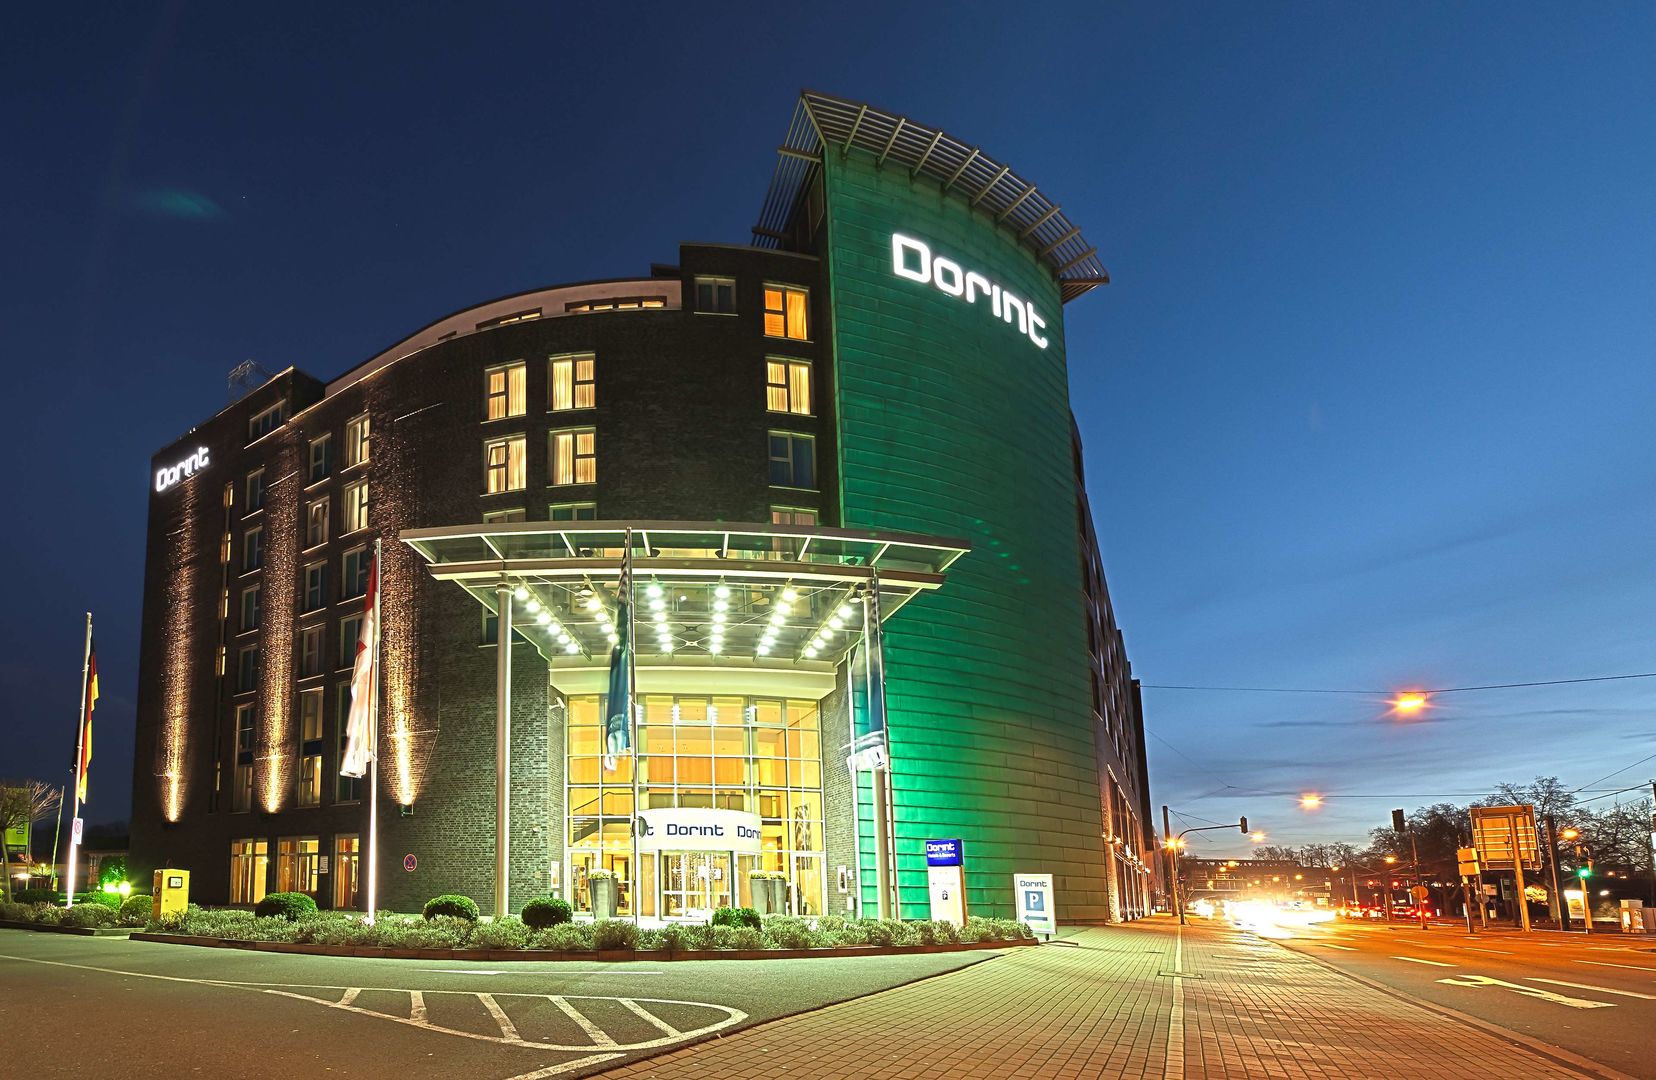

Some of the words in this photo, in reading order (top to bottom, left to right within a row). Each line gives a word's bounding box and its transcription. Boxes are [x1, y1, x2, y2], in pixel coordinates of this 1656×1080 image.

[892, 233, 1048, 349] Dorint
[156, 447, 209, 492] Dorint
[667, 823, 724, 836] Dorint
[926, 842, 955, 852] Dorint
[1030, 892, 1039, 909] P
